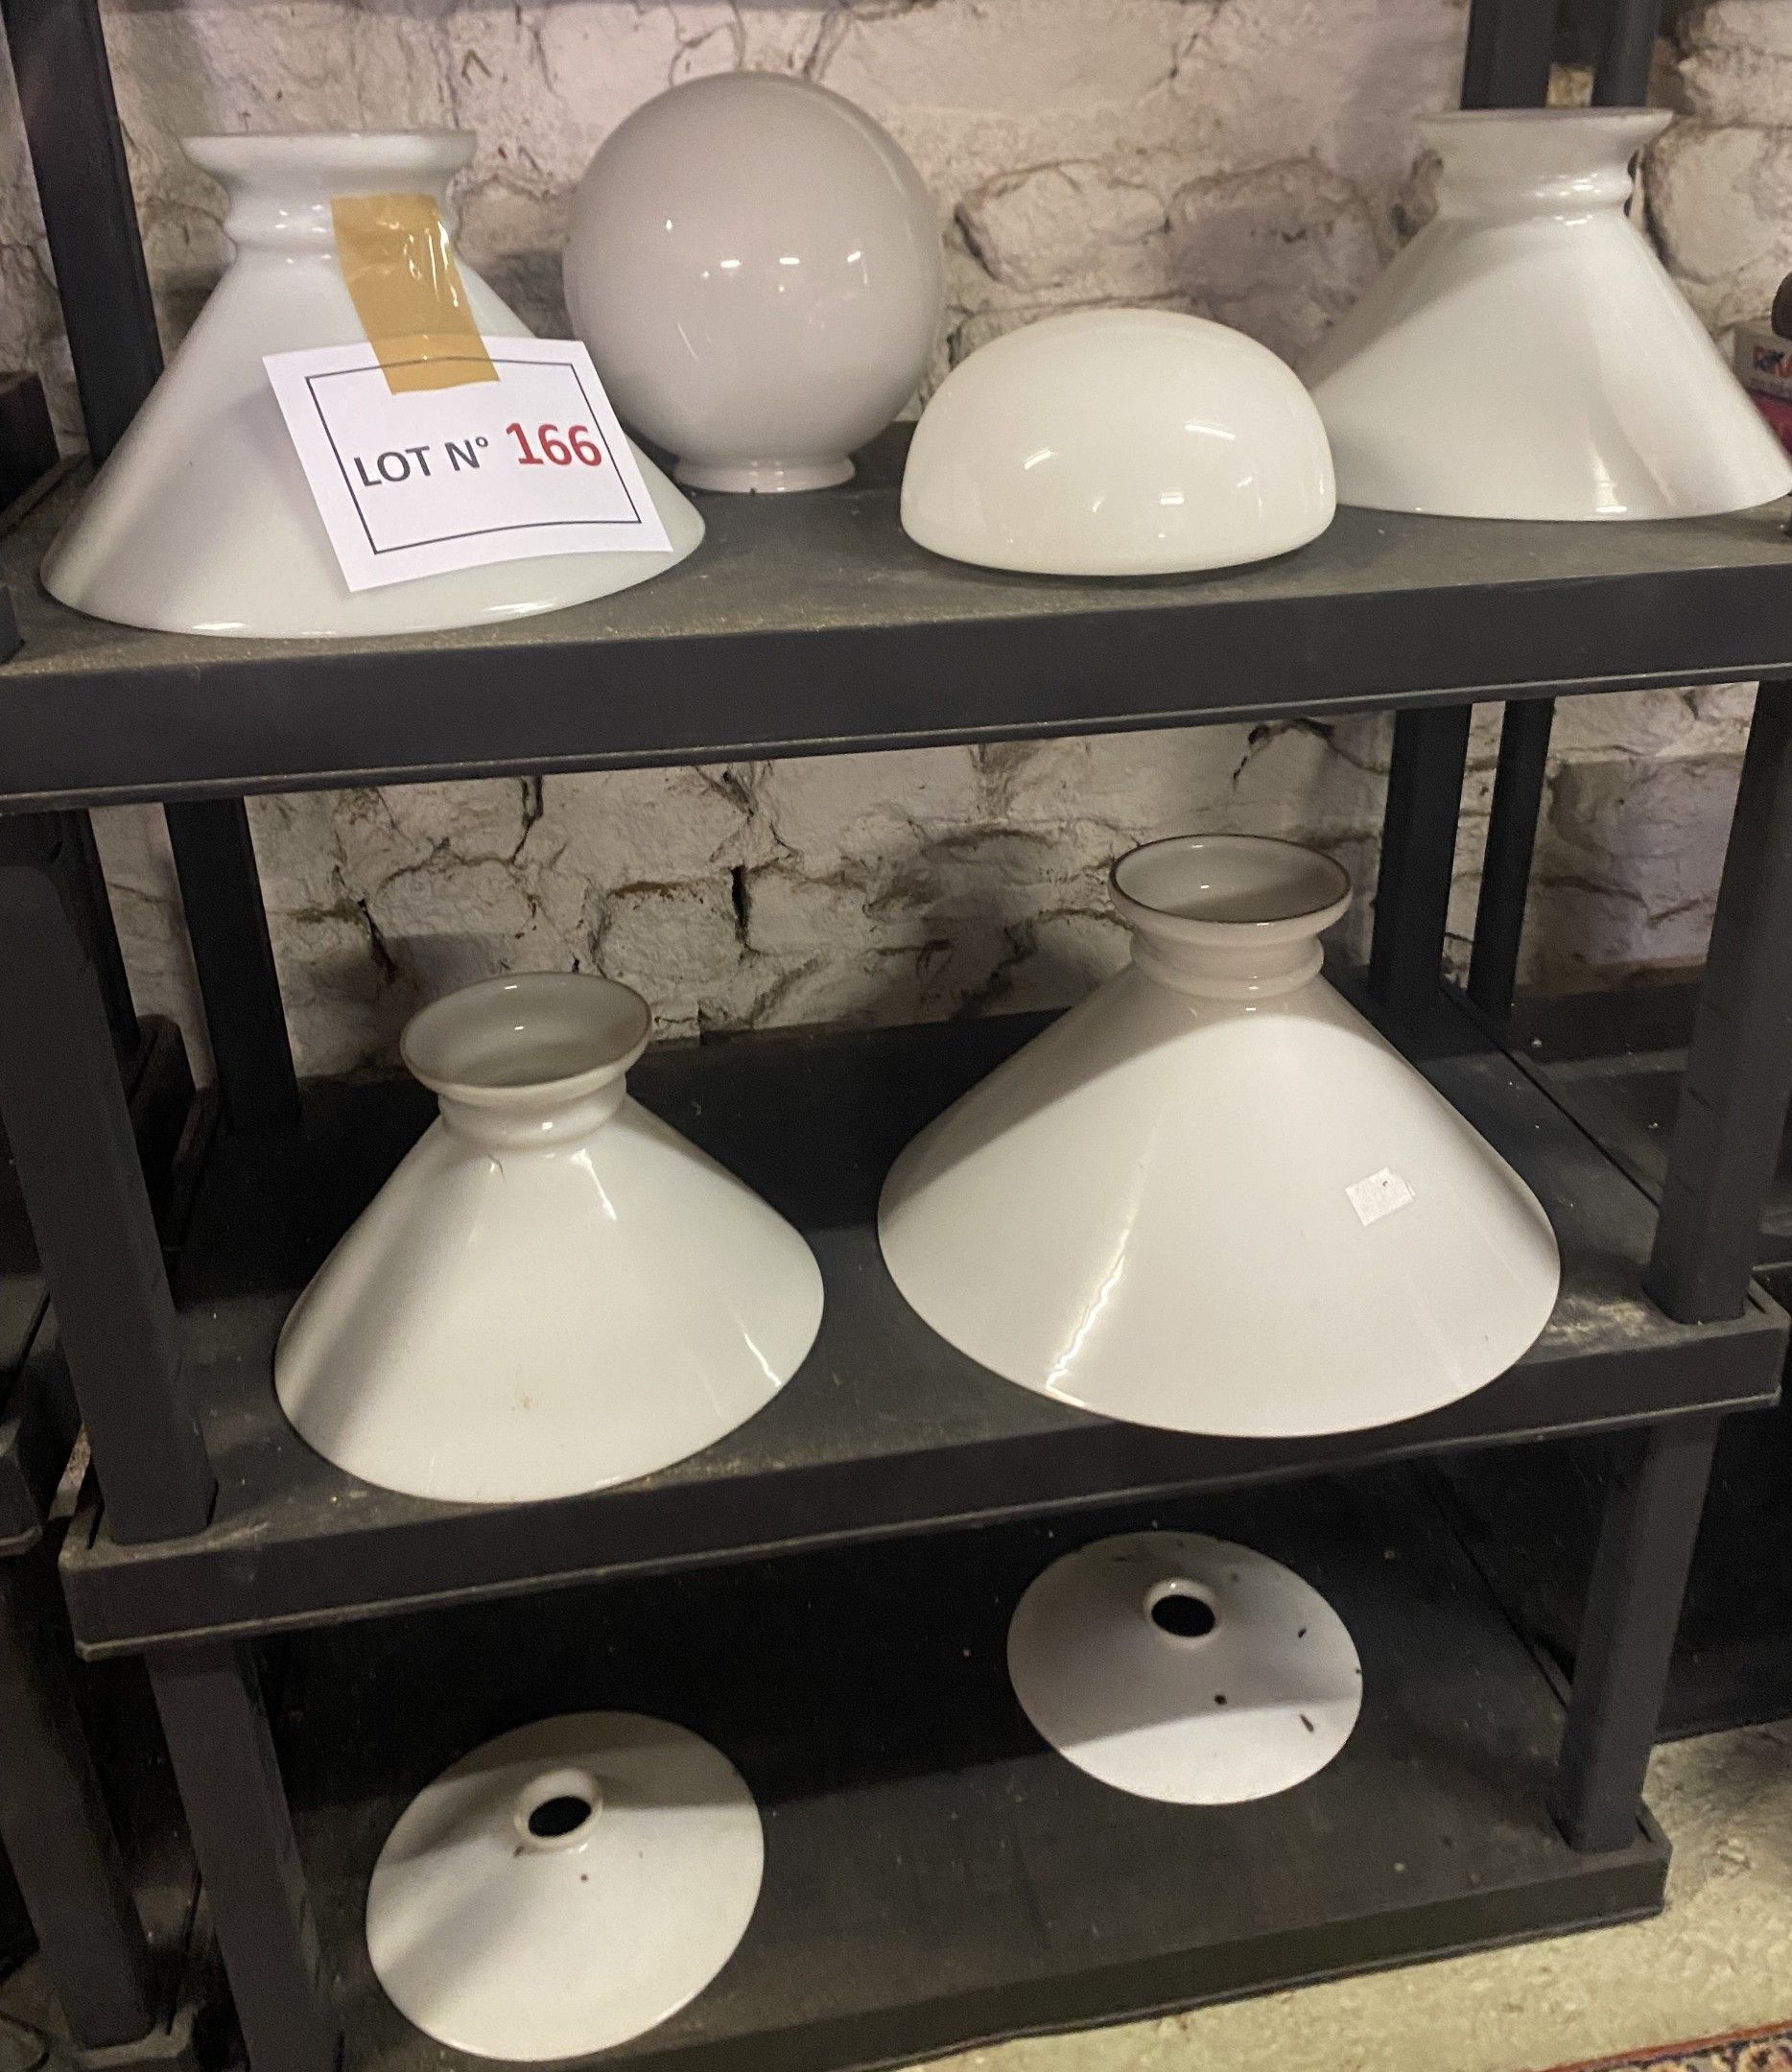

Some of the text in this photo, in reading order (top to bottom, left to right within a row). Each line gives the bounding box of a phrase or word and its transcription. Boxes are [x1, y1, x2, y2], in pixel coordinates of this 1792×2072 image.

[354, 422, 602, 487] LOT N° 166
